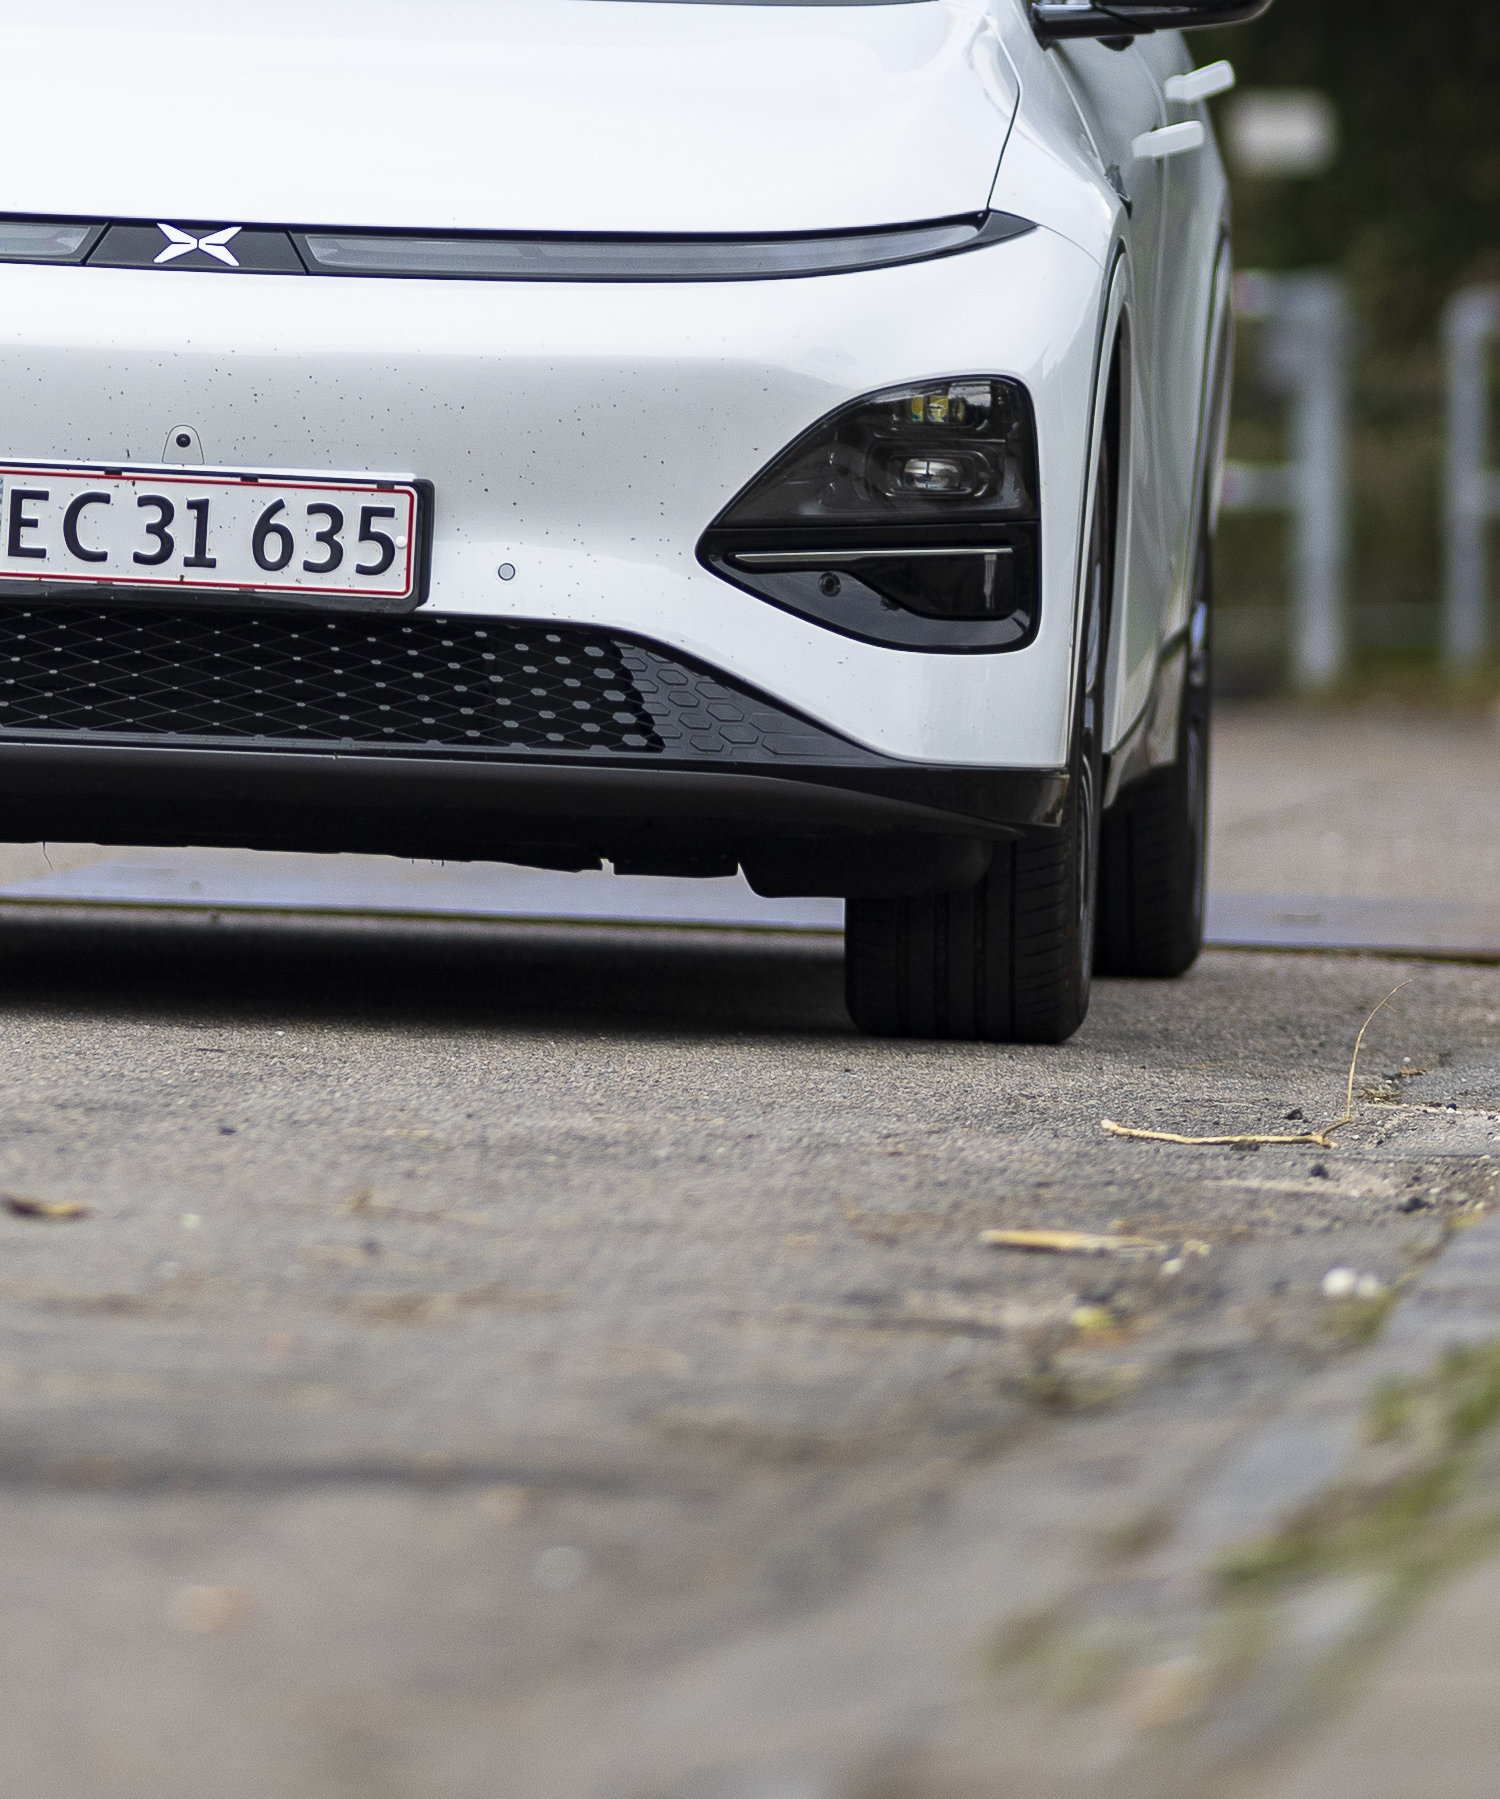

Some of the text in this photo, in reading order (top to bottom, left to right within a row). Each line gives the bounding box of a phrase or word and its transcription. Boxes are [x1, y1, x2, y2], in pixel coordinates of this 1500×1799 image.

[7, 488, 396, 576] EC 31 635
